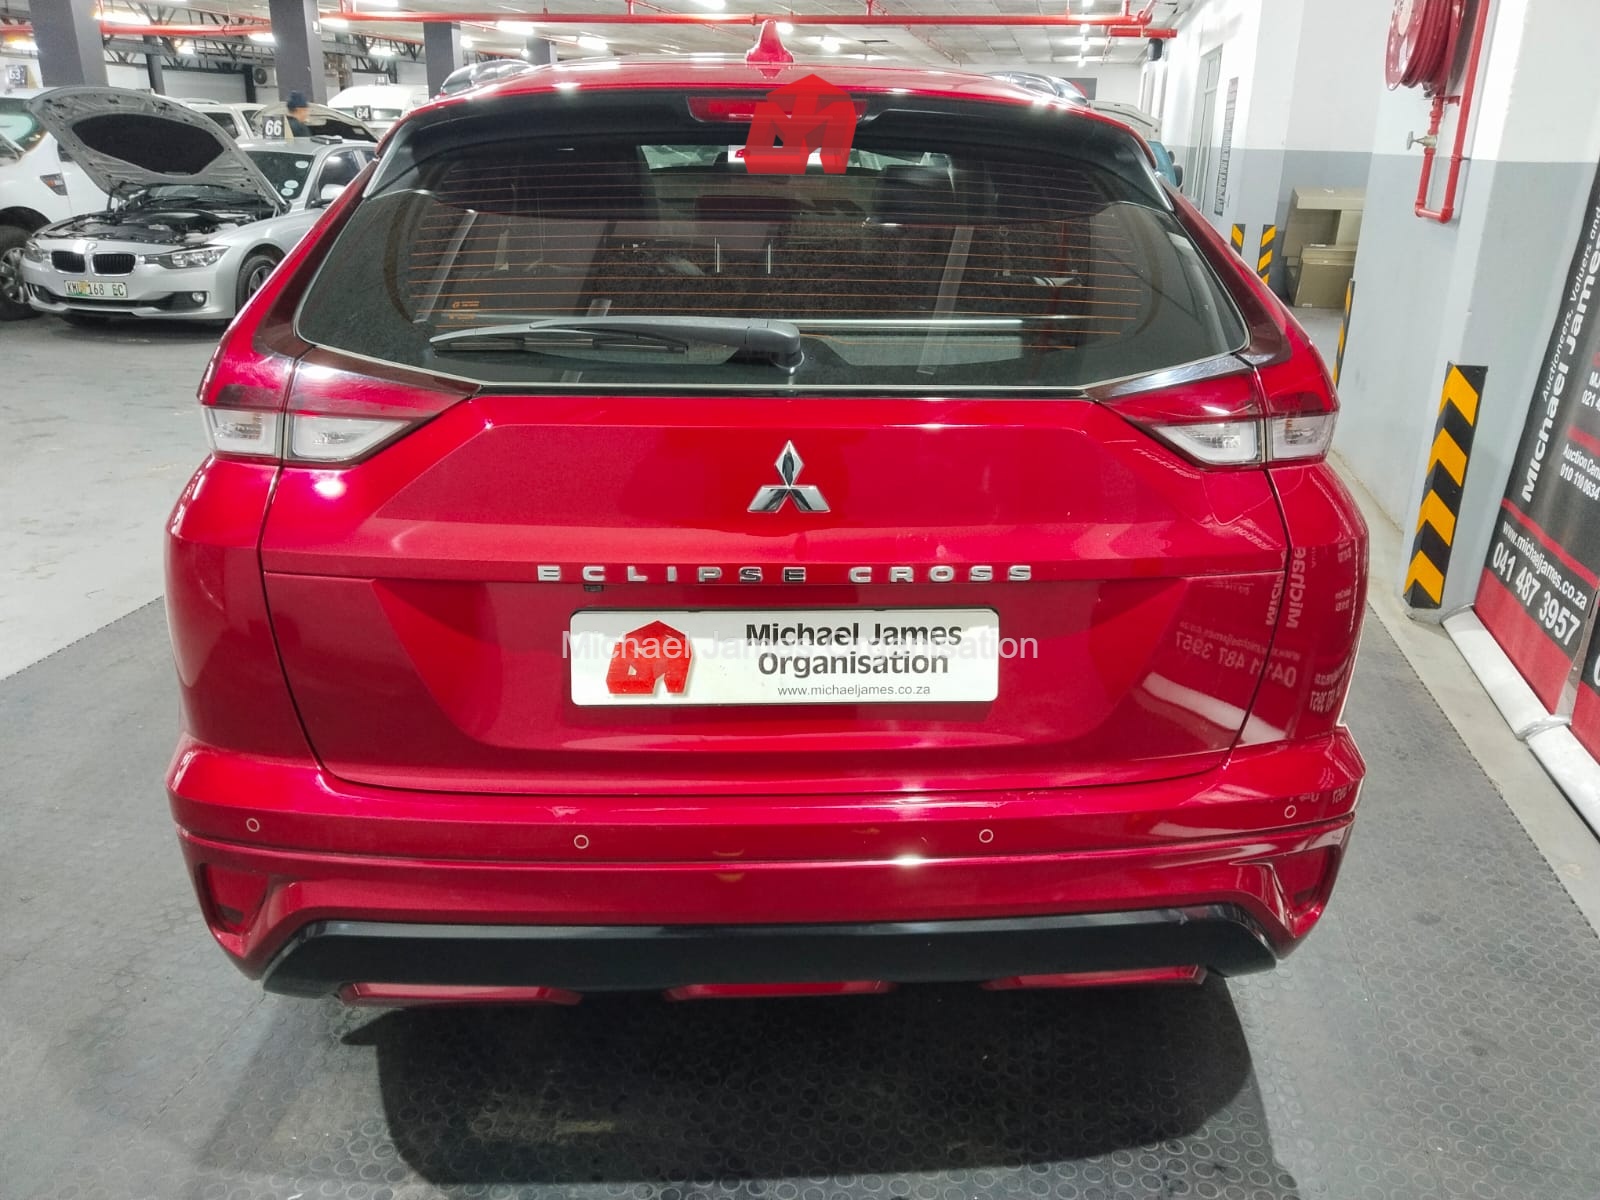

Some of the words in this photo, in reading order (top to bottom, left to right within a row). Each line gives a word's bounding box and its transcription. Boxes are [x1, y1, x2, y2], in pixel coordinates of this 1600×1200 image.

[356, 107, 369, 119] 64
[265, 120, 282, 135] 66
[88, 283, 105, 296] 168
[112, 284, 124, 297] EC
[1542, 309, 1574, 402] Auctioneers,
[1569, 243, 1592, 301] Valuers
[1521, 362, 1569, 503] Michael
[1566, 232, 1600, 355] Jame
[1563, 443, 1588, 470] Auction
[1560, 463, 1574, 481] 010
[537, 565, 806, 583] ECLIPSE
[849, 565, 1032, 583] CROSS
[1503, 520, 1588, 611] www.michaeljames.co.za
[1493, 542, 1516, 582] 041
[1515, 566, 1541, 607] 487
[1539, 590, 1581, 646] 3957
[745, 623, 860, 647] Michael
[867, 623, 963, 647] James
[758, 650, 950, 679] Organisation
[777, 683, 931, 699] www.michaeljames.co.za
